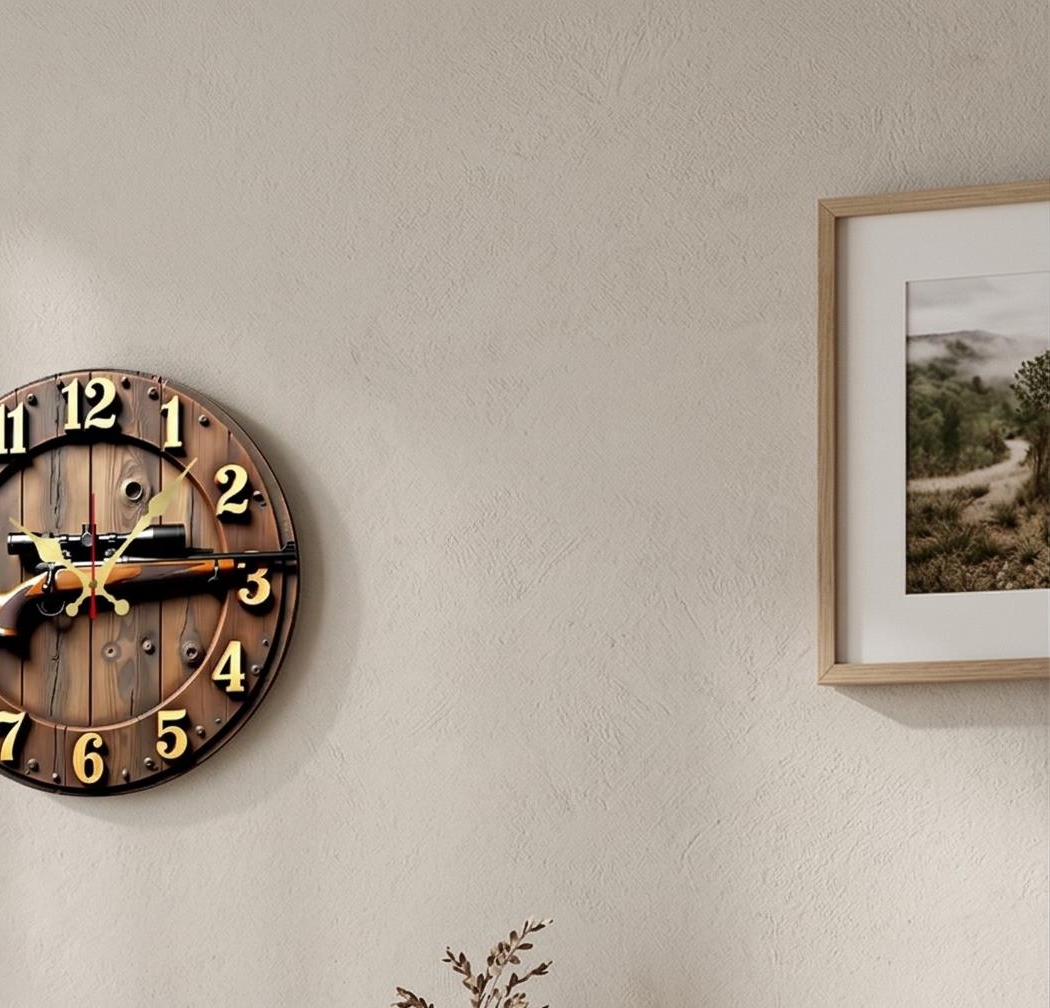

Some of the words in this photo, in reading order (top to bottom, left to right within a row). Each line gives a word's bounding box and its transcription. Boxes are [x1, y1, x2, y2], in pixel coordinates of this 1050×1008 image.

[62, 377, 117, 430] 12
[160, 396, 183, 447] 1
[216, 464, 249, 515] 2
[212, 641, 245, 692] 4
[72, 732, 104, 784] 6
[156, 709, 187, 759] 5
